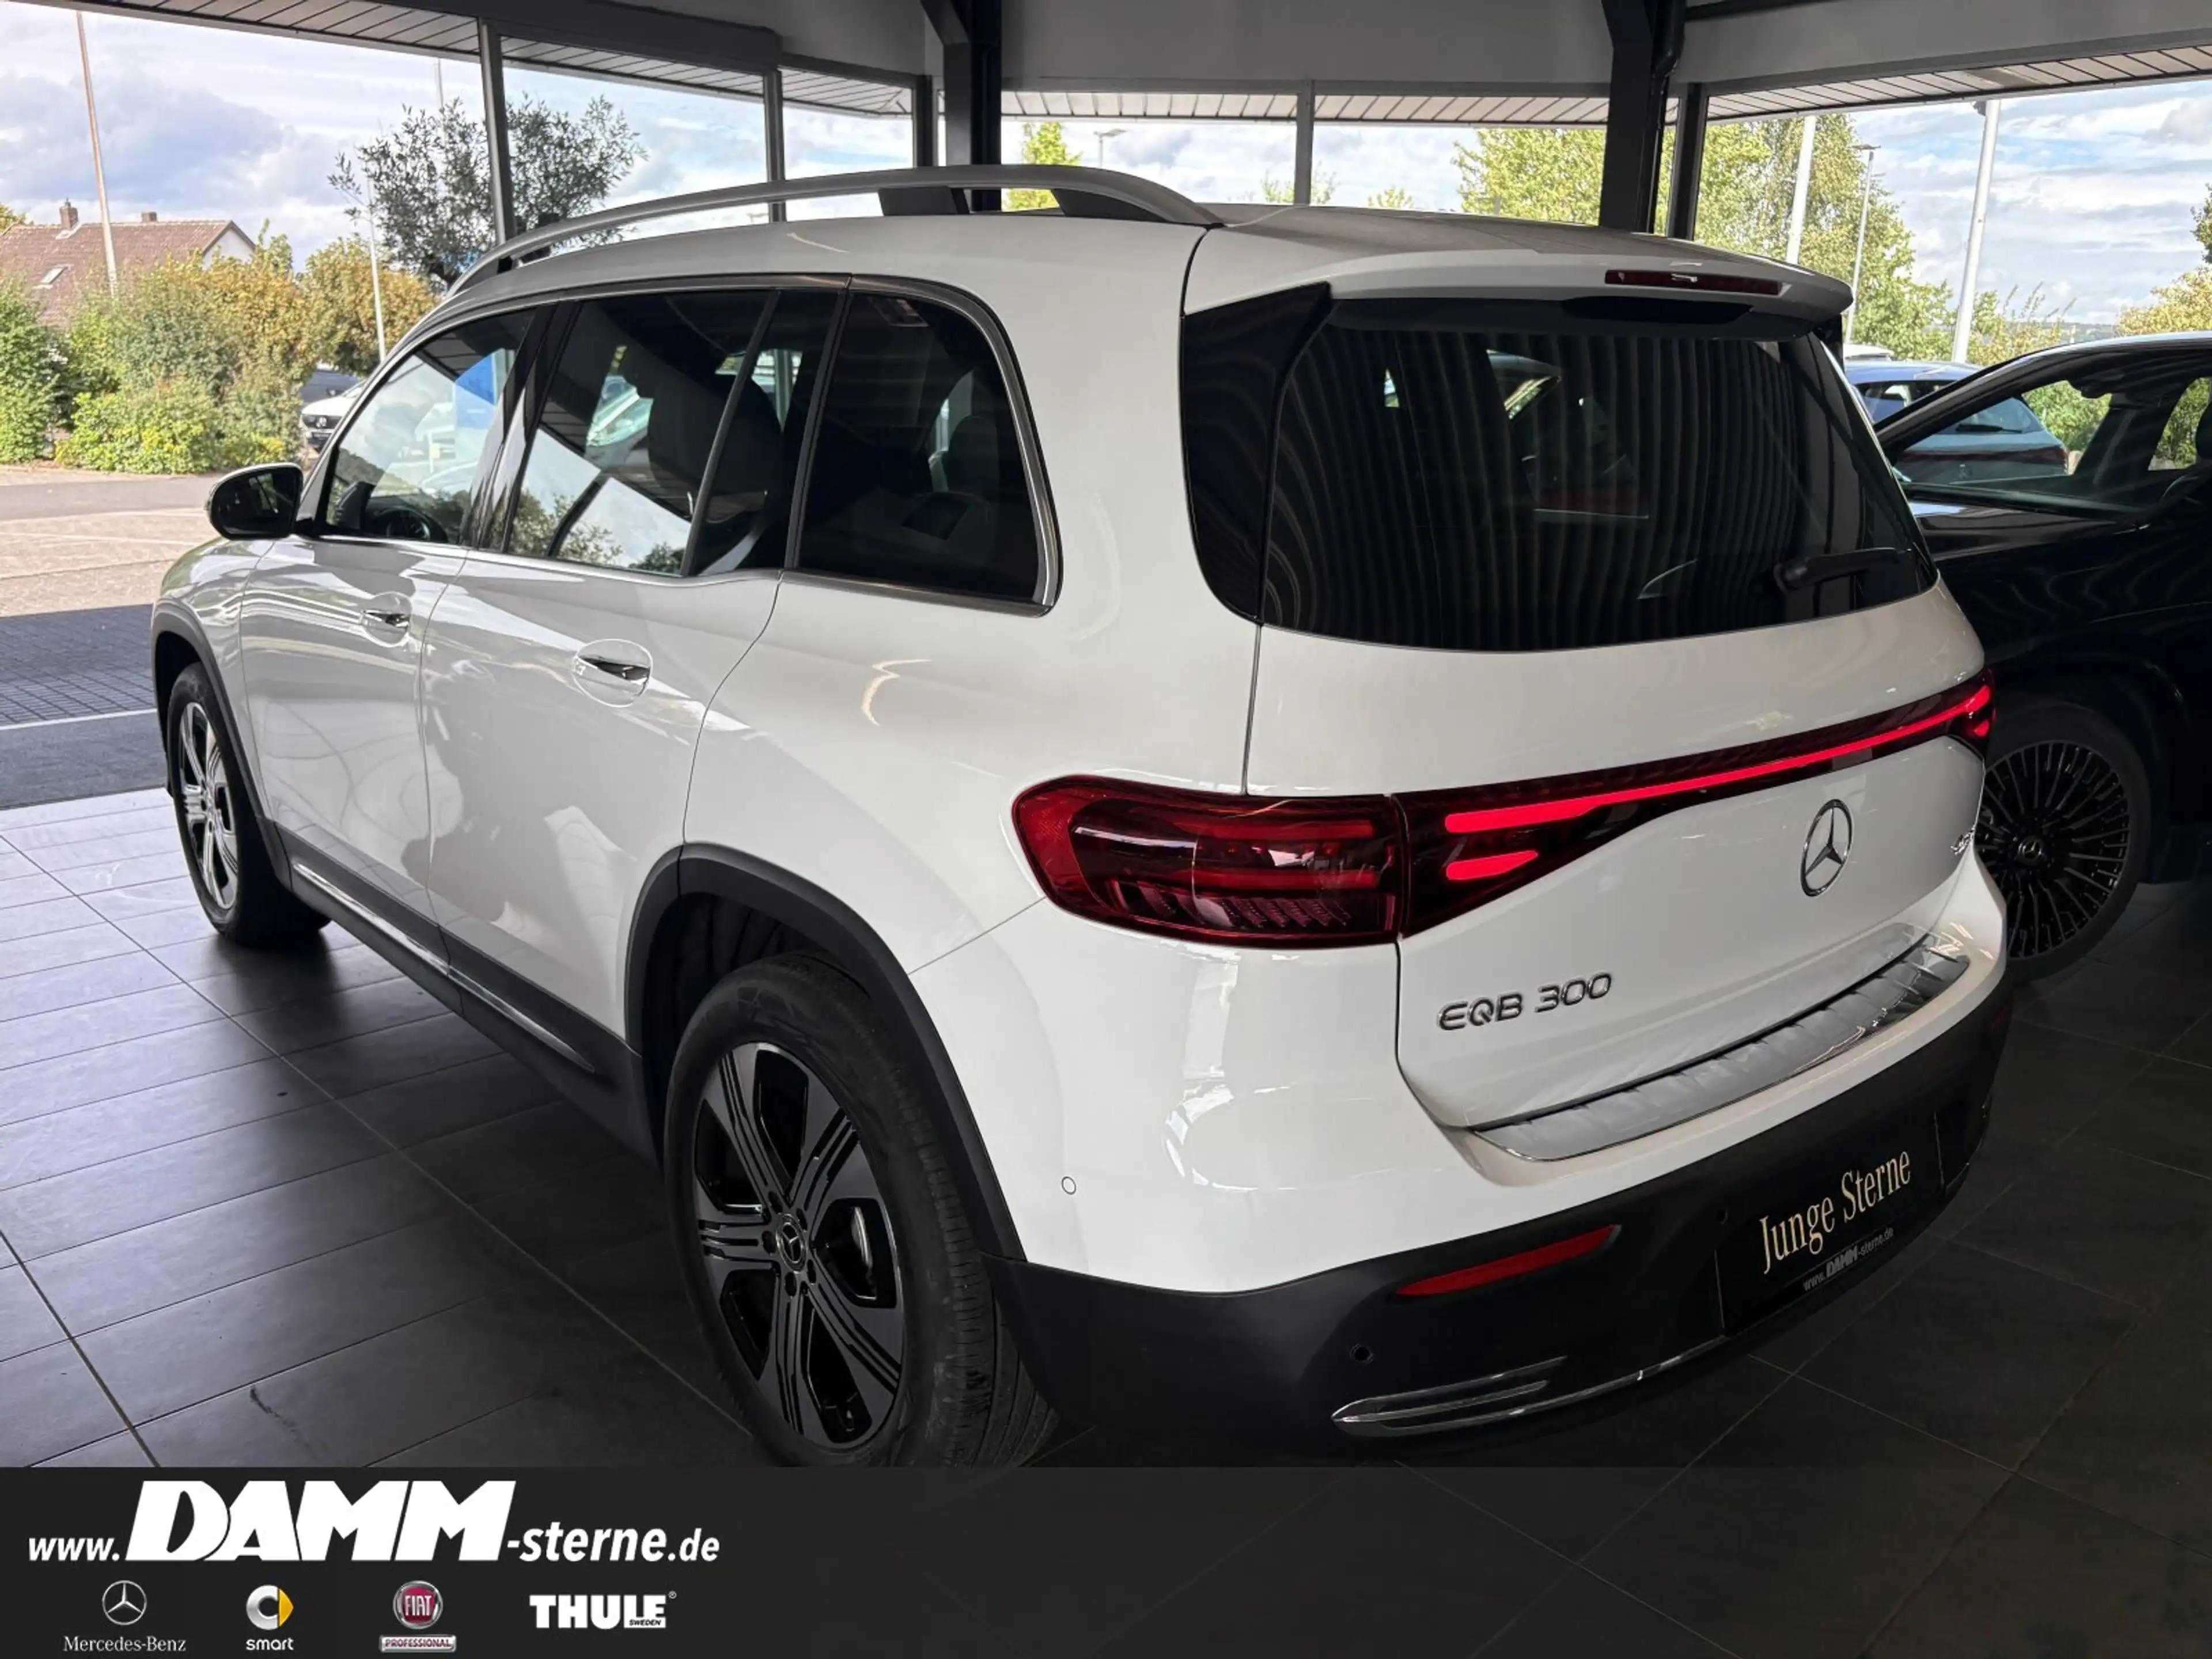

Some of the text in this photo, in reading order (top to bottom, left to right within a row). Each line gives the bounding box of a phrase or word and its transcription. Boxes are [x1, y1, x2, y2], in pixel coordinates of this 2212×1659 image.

[1437, 971, 1612, 1031] EQB 300
[1760, 1151, 1911, 1274] Junge Sterne
